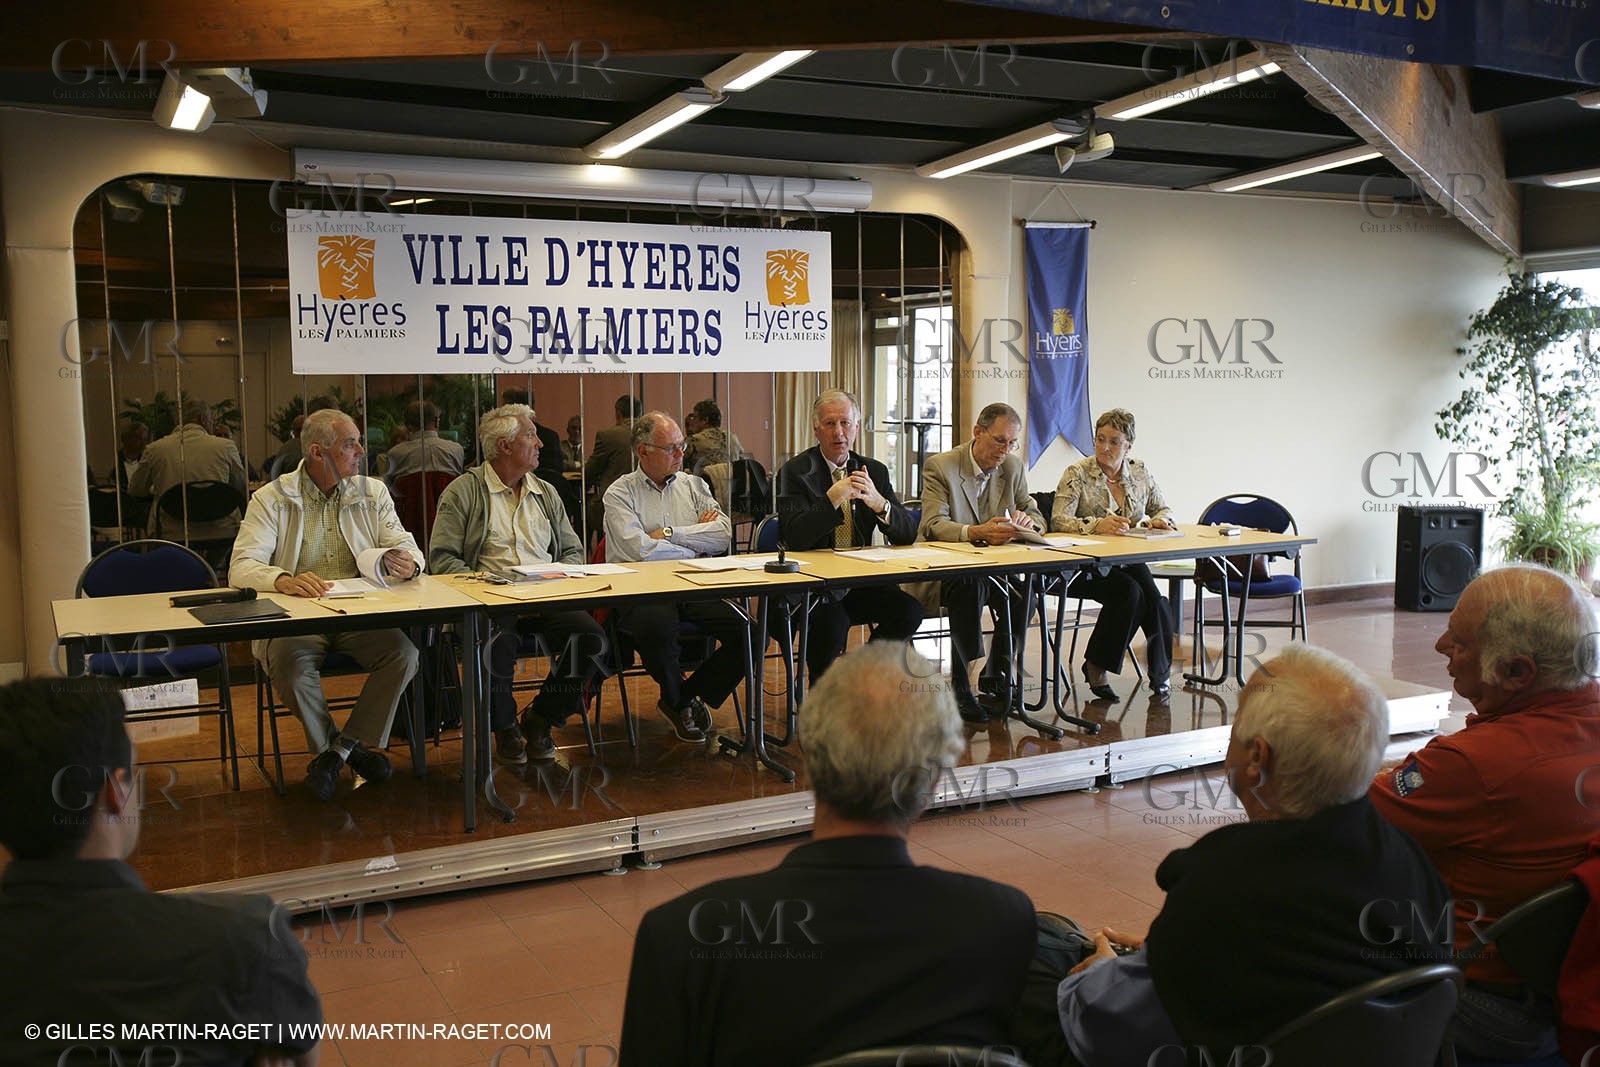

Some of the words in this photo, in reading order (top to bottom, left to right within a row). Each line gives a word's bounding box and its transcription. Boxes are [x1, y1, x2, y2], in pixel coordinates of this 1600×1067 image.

[402, 234, 528, 286] VILLE
[544, 237, 741, 293] D'HYERES
[297, 293, 407, 342] Hyères
[299, 329, 325, 339] LES
[336, 329, 406, 339] PALMIERS
[436, 304, 513, 356] LES
[528, 305, 722, 357] PALMIERS
[745, 300, 828, 343] Hyères
[745, 331, 765, 341] LES
[772, 331, 826, 341] PALMIERS
